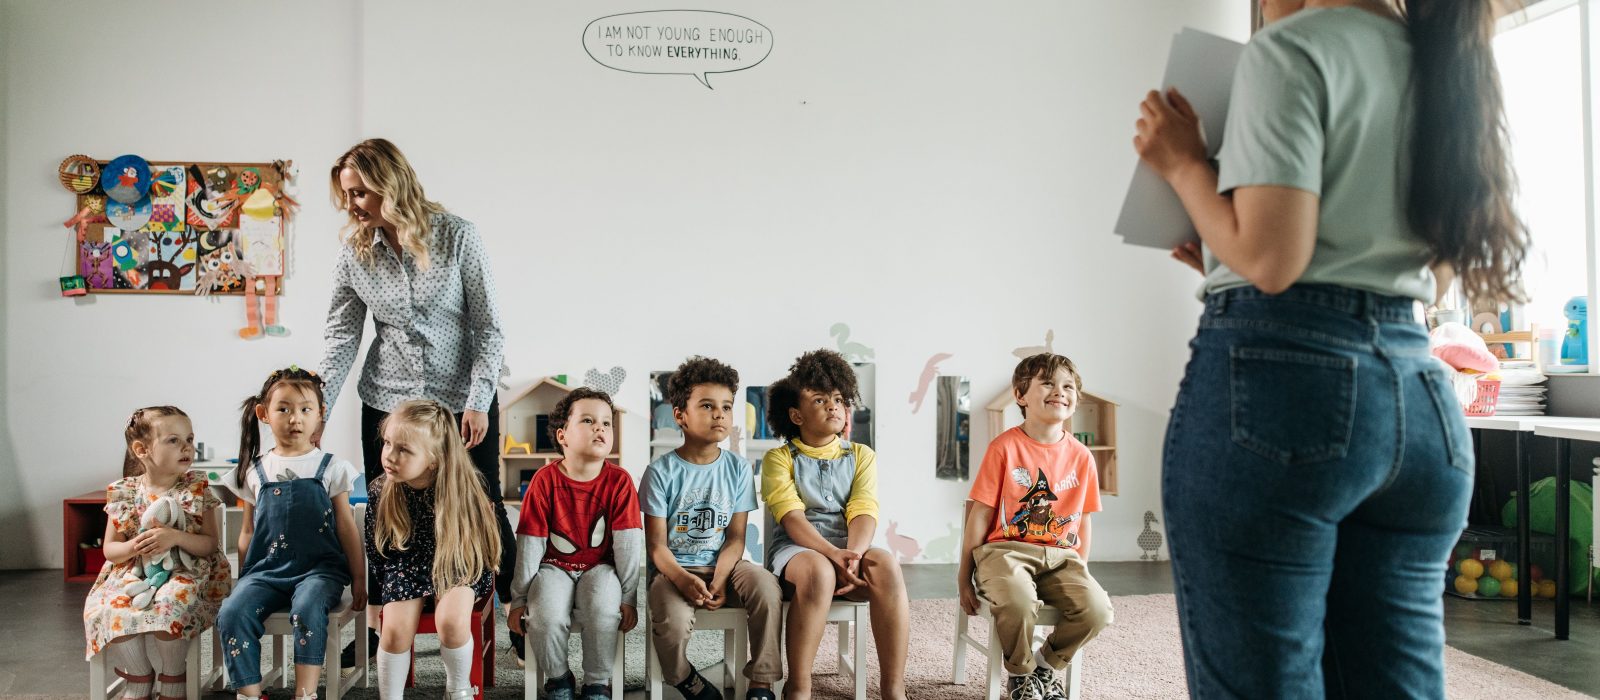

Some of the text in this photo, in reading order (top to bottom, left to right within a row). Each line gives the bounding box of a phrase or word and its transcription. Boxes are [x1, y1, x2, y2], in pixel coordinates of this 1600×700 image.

[605, 26, 622, 39] AM
[626, 26, 651, 39] NOT
[657, 27, 700, 41] YOUNG
[710, 28, 763, 44] ENOUGH
[606, 44, 741, 61] TO KNOW EVERYTHING.
[677, 514, 689, 525] 19
[717, 514, 728, 527] 82
